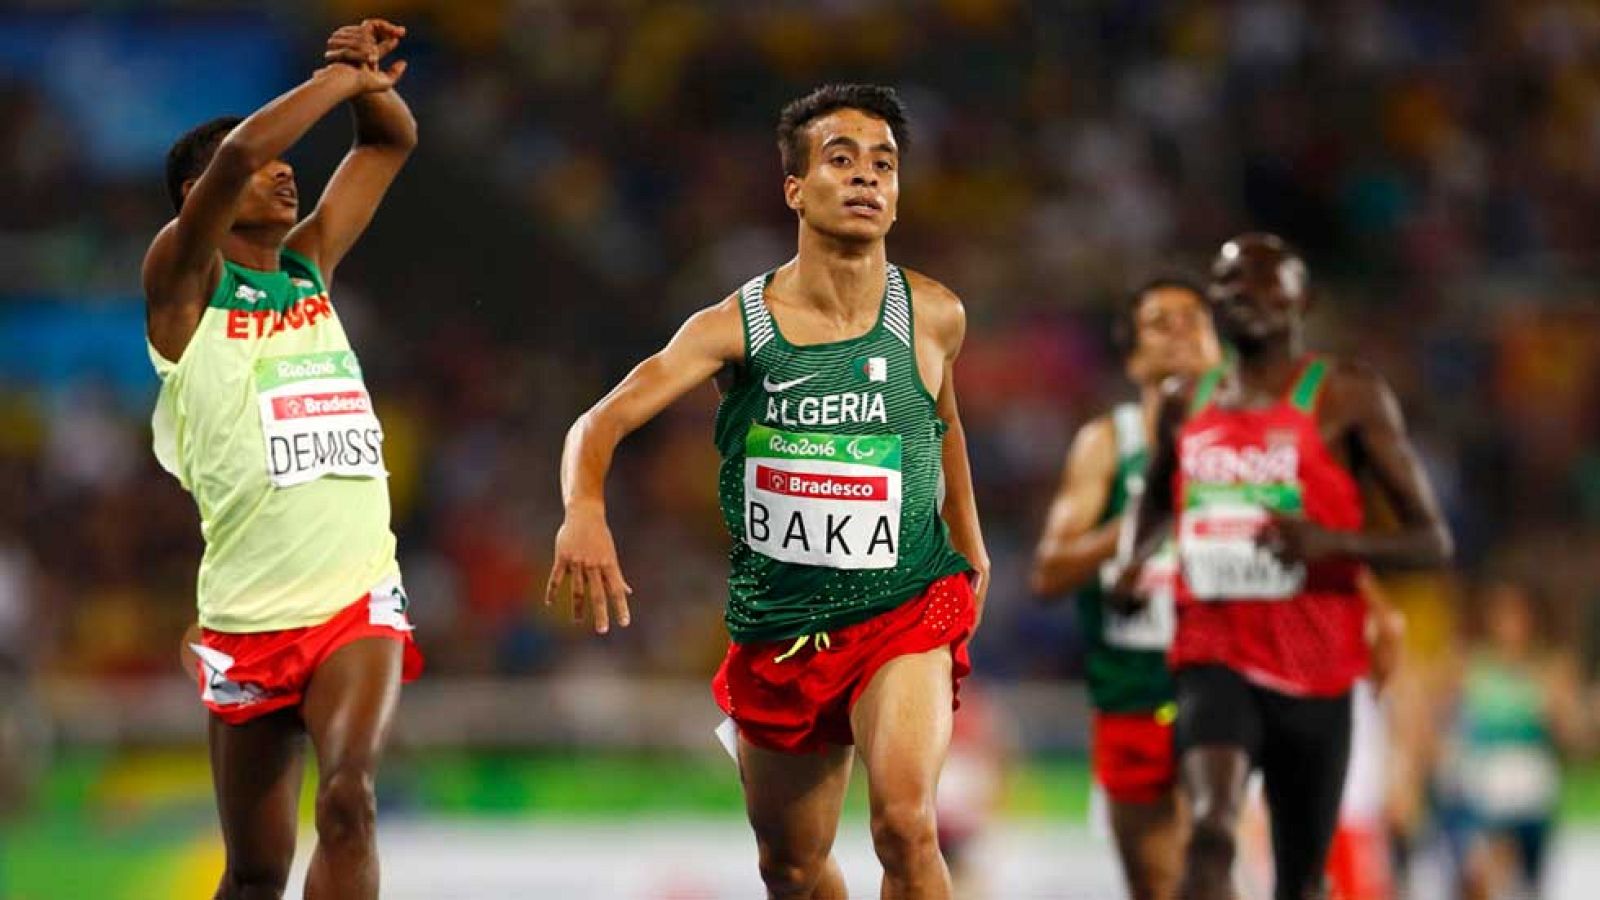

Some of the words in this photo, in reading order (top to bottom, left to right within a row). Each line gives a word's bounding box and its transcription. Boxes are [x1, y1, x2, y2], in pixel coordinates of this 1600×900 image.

[765, 392, 887, 426] ALGERIA
[769, 435, 836, 456] Rio2016
[789, 477, 873, 497] Bradesco
[749, 501, 895, 555] BAKA
